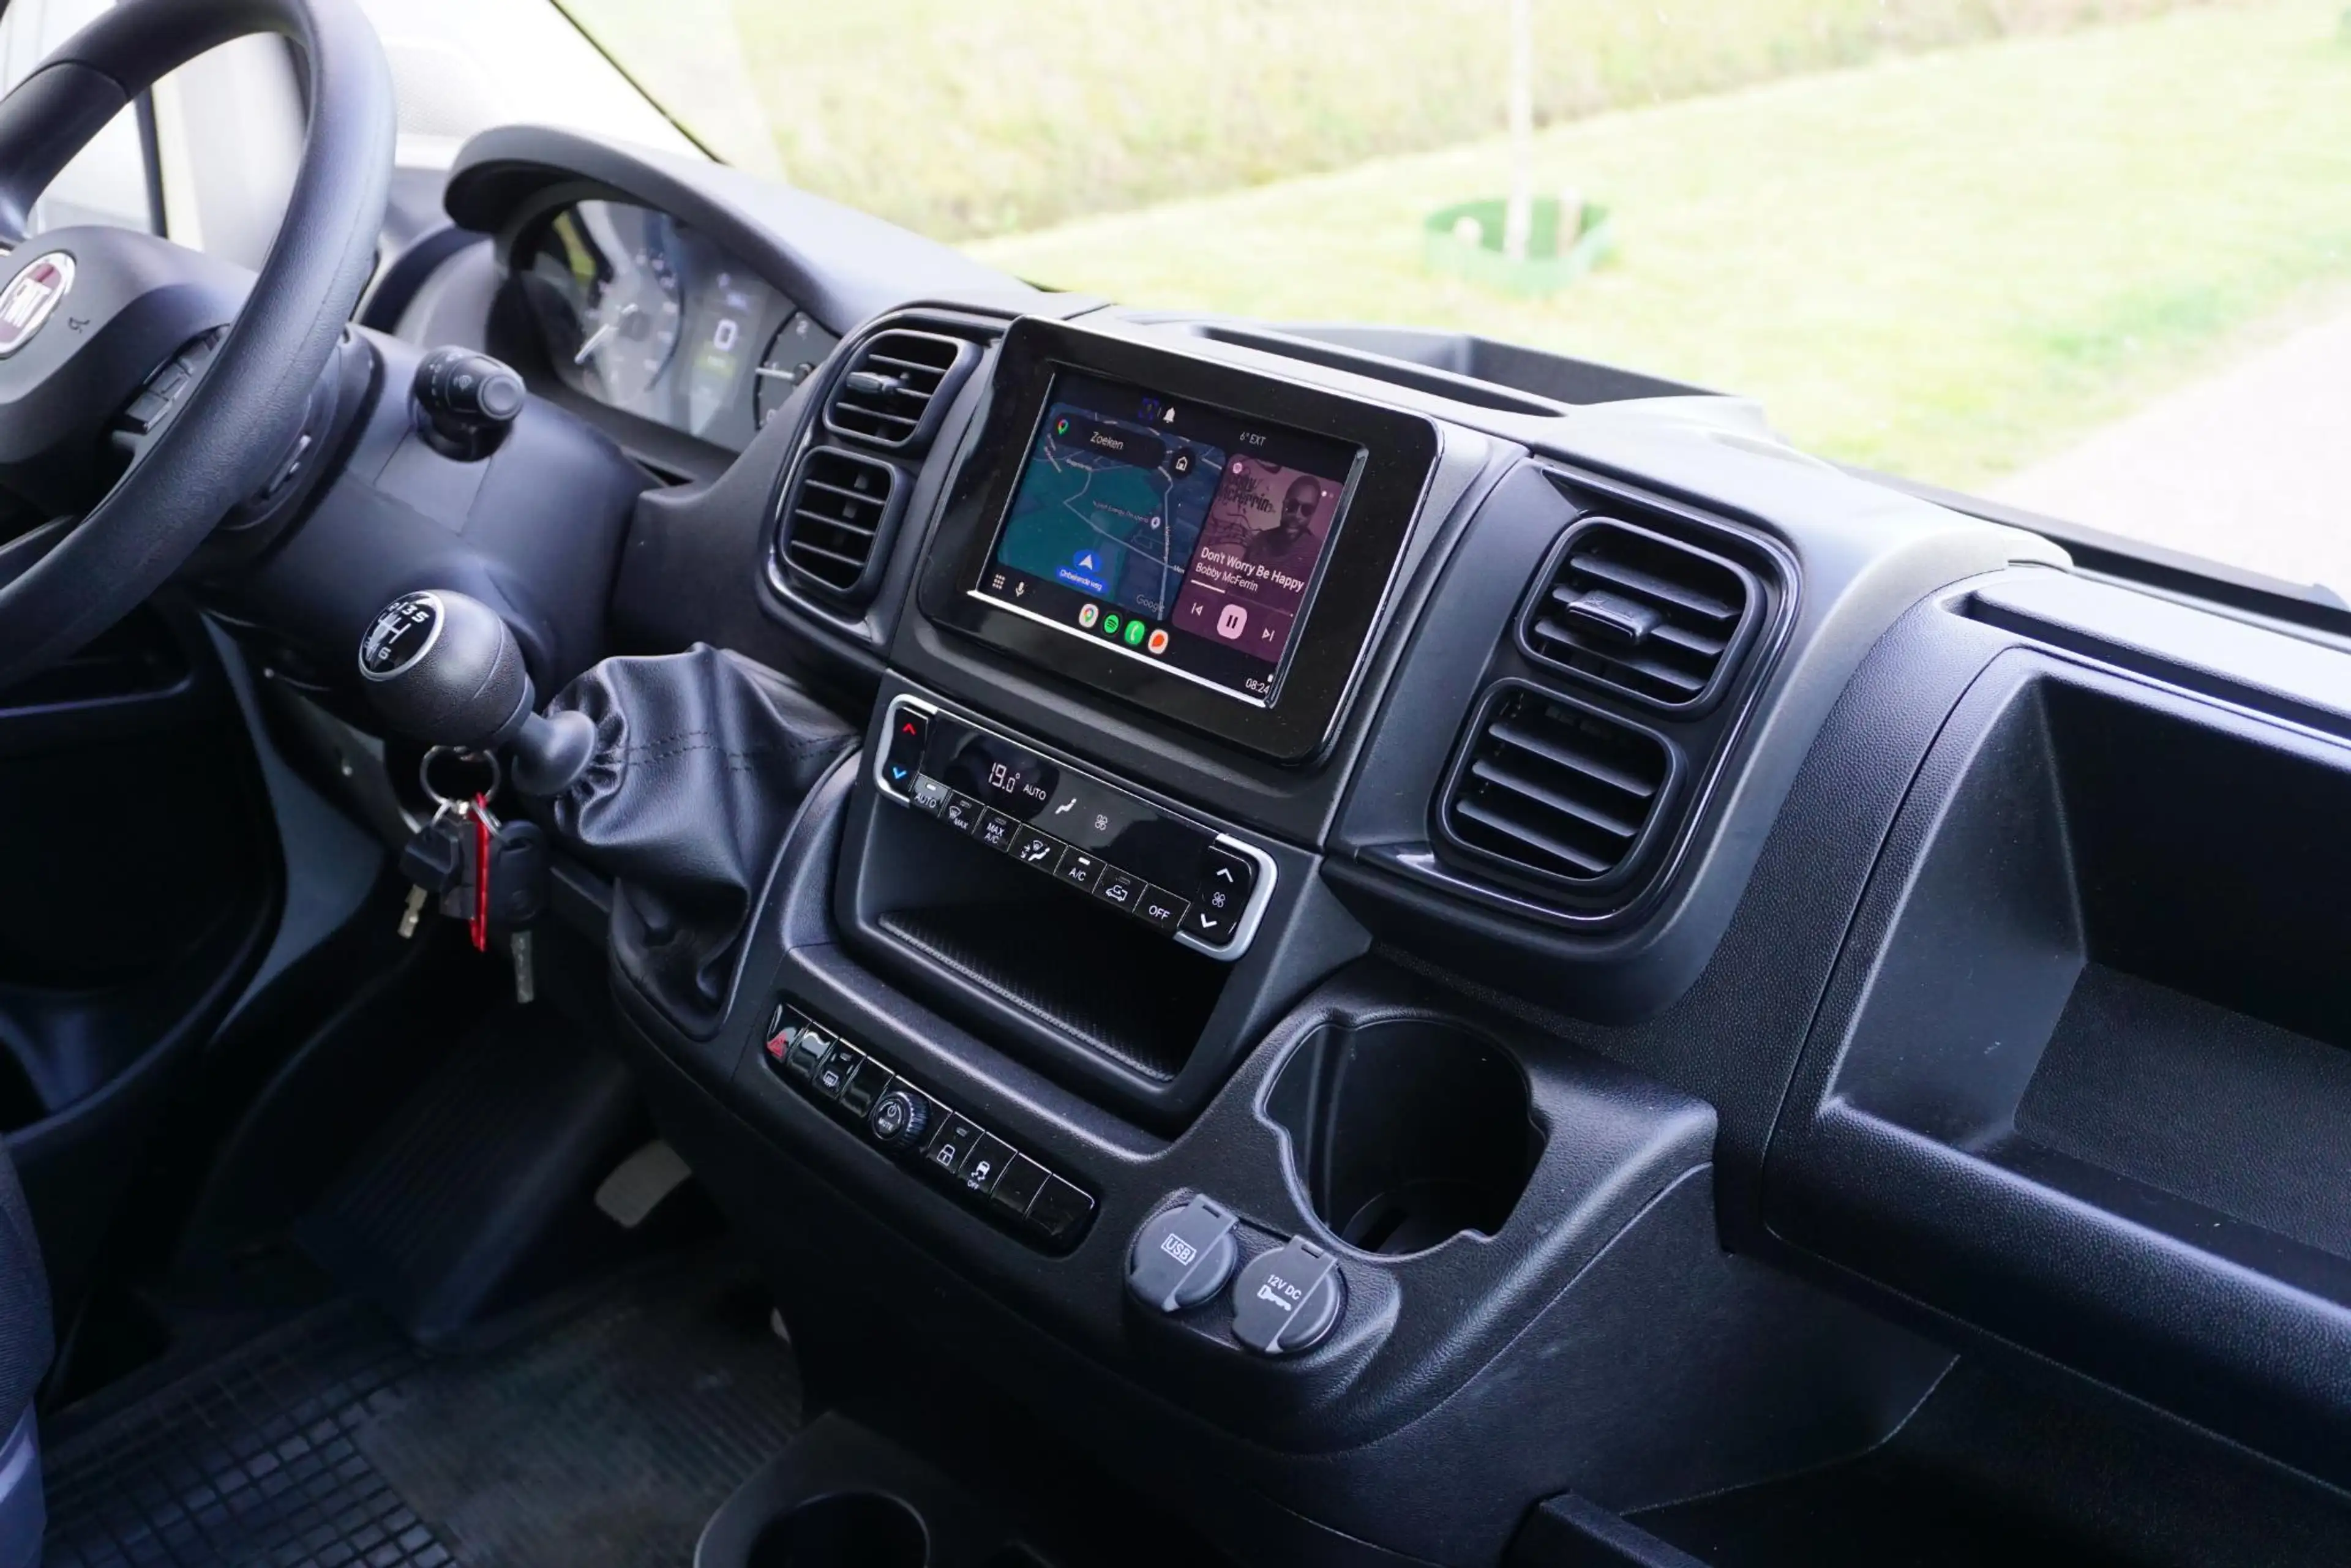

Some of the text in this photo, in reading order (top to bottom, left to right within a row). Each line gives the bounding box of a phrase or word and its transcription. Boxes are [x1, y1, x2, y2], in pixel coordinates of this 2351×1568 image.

[1090, 432, 1124, 450] Zoeken
[1249, 434, 1266, 446] EXT
[1196, 562, 1222, 580] Bobby
[1222, 571, 1258, 591] McFerrin
[1201, 547, 1305, 593] Don't Worry Be Happy
[402, 604, 418, 615] 3
[411, 611, 430, 623] 5
[378, 647, 392, 660] 6
[1245, 678, 1270, 694] 08:24
[914, 792, 937, 808] AUTO
[1022, 784, 1047, 801] AUTO
[954, 817, 969, 830] MAX
[986, 822, 1005, 837] MAX
[984, 832, 1000, 844] A/C
[1068, 867, 1086, 882] A/C
[1149, 905, 1171, 919] OFF
[967, 1179, 980, 1190] OFF
[1166, 1237, 1191, 1260] USB
[1267, 1274, 1302, 1300] 12V DC
